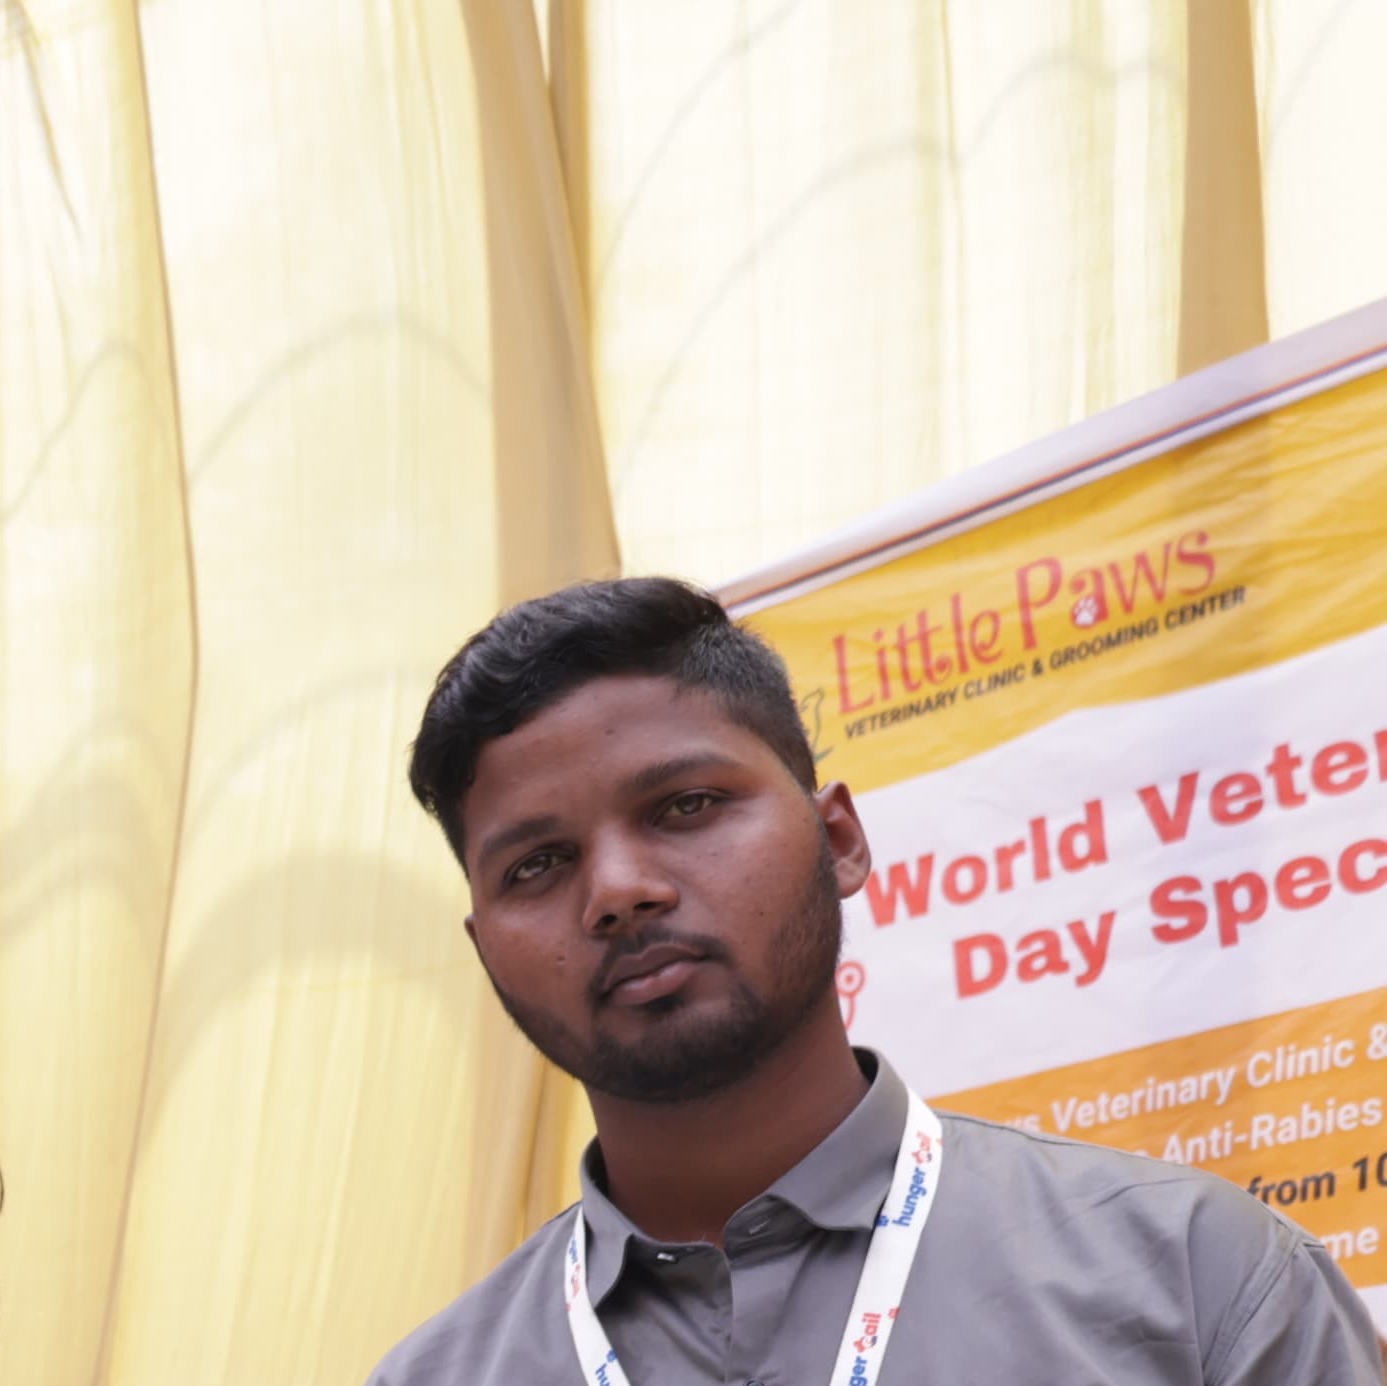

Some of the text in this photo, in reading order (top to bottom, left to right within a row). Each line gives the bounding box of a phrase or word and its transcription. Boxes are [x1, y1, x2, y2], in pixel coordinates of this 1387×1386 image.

[833, 530, 1218, 714] Little Paws
[844, 585, 1247, 739] VETERINARY CLINIC & GROOMING CENTER
[864, 799, 1109, 929] World
[952, 911, 1116, 999] Day
[1051, 1023, 1387, 1133] Veterinary Clinic &
[1161, 1096, 1384, 1165] Anti-Rabies
[892, 1166, 927, 1227] hunger
[1247, 1171, 1336, 1206] from
